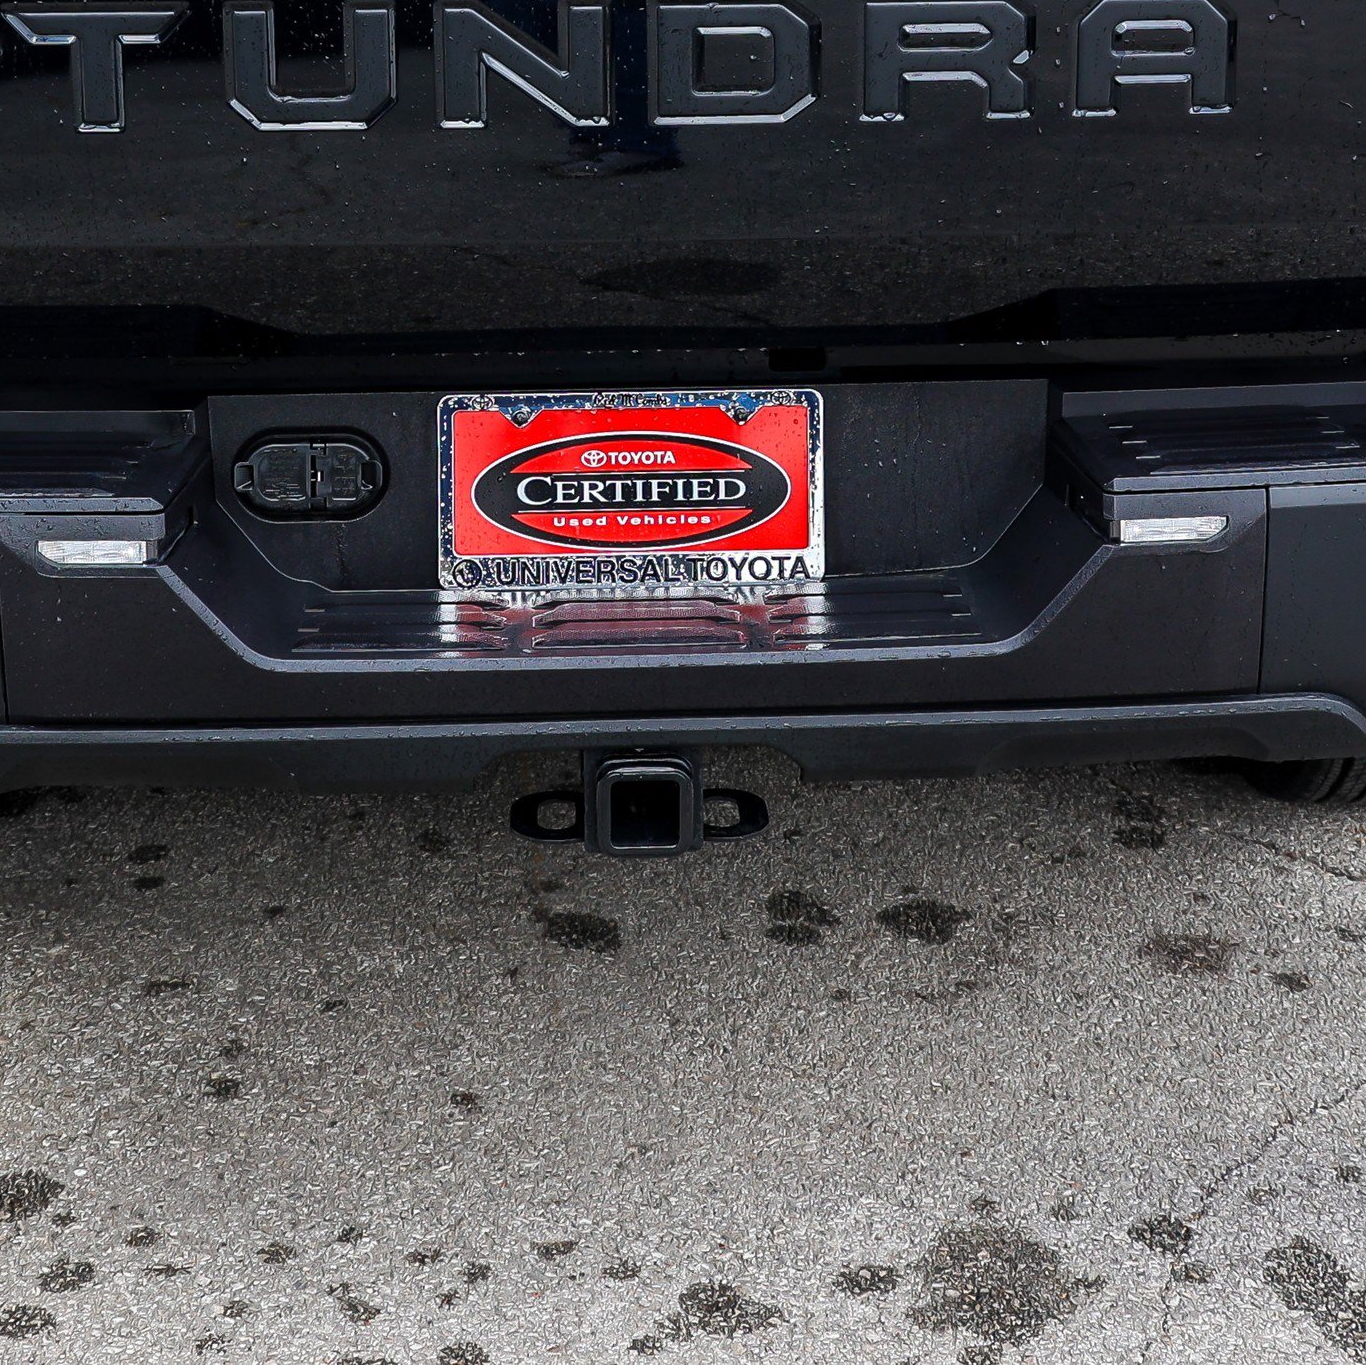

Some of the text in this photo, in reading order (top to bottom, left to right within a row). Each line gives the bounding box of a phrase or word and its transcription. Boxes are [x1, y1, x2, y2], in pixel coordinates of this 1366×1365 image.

[607, 450, 676, 466] TOYOTA
[517, 475, 747, 506] CERTIFIED
[553, 513, 712, 528] Used Vehicles
[495, 557, 684, 586] UNIVERSAL
[686, 555, 812, 582] TOYOTA
